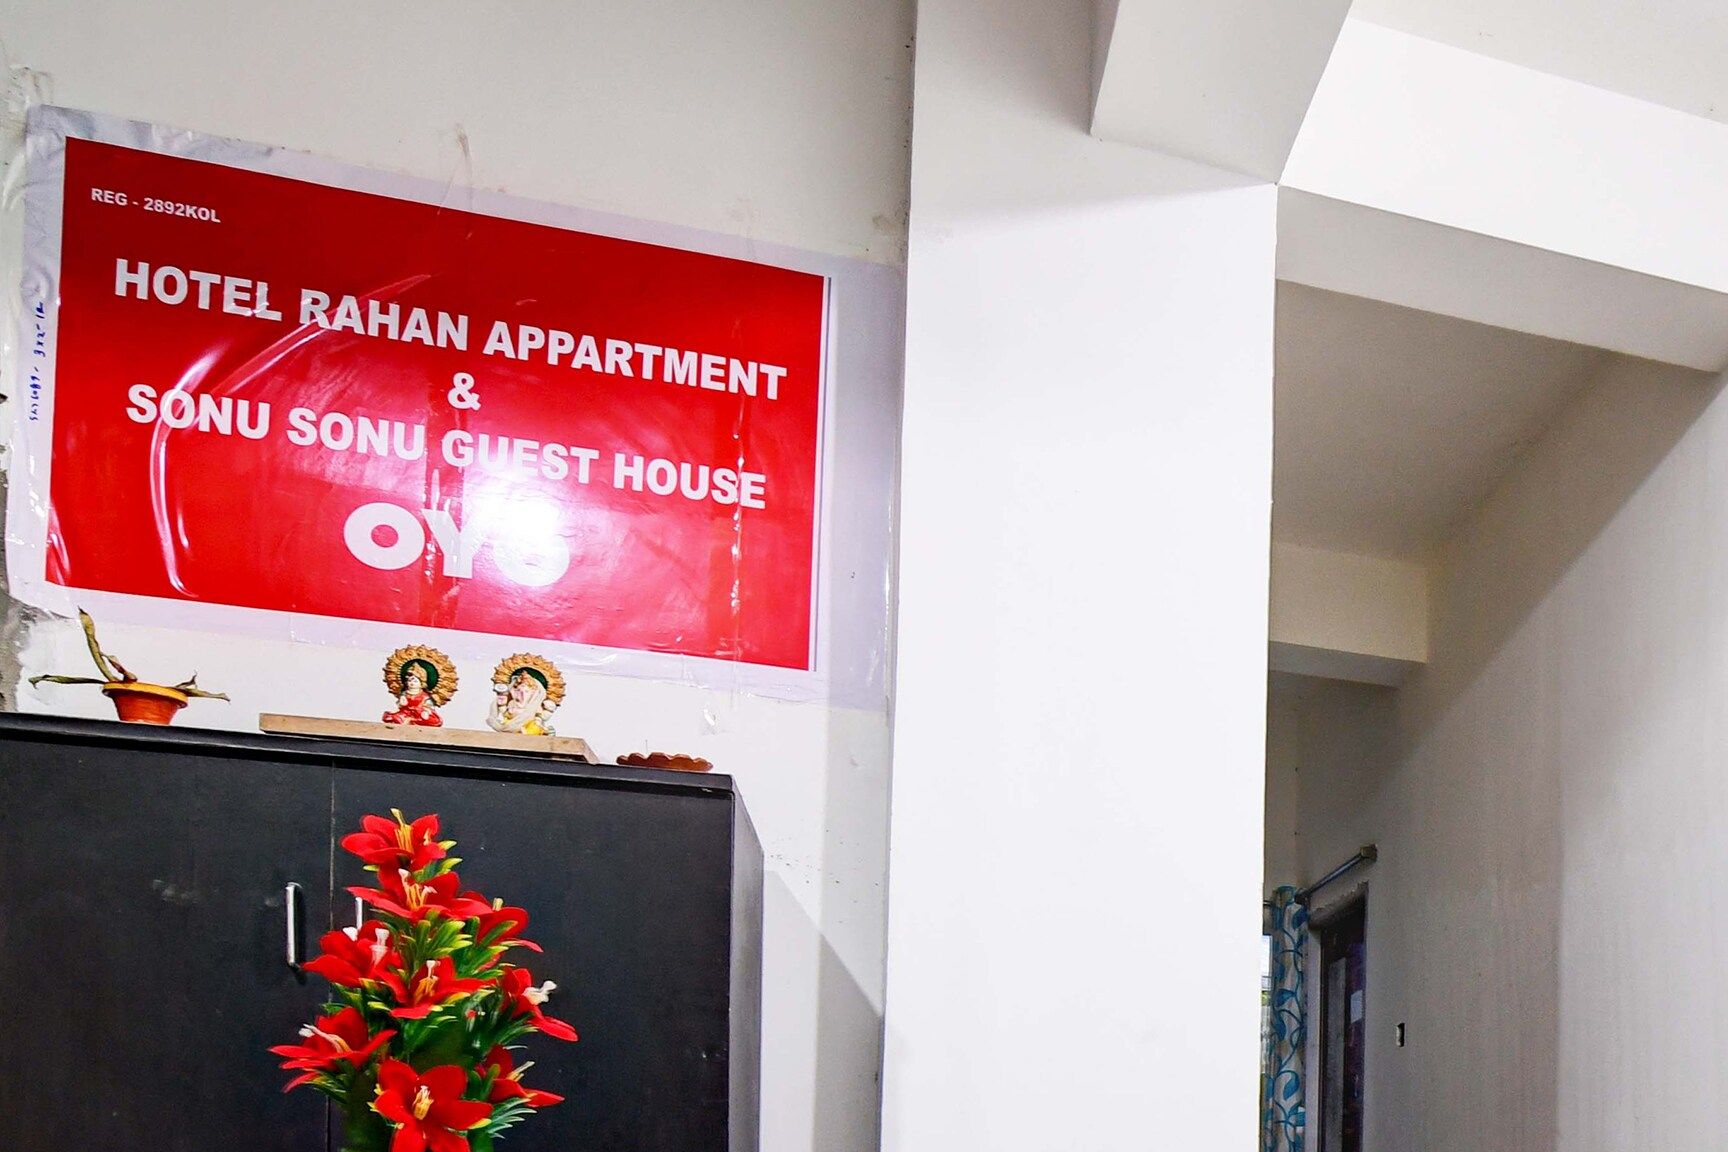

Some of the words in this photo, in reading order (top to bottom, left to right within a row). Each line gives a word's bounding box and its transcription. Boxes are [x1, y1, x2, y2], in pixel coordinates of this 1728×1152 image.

[91, 187, 128, 206] REG
[143, 197, 221, 223] 2892KOL
[115, 258, 282, 321] HOTEL
[299, 288, 469, 351] RAHAN
[482, 320, 787, 400] APPARTMENT
[447, 372, 481, 411] &
[125, 383, 271, 440] SONU
[286, 407, 426, 461] SONU
[441, 429, 600, 484] GUEST
[612, 452, 767, 510] HOUSE
